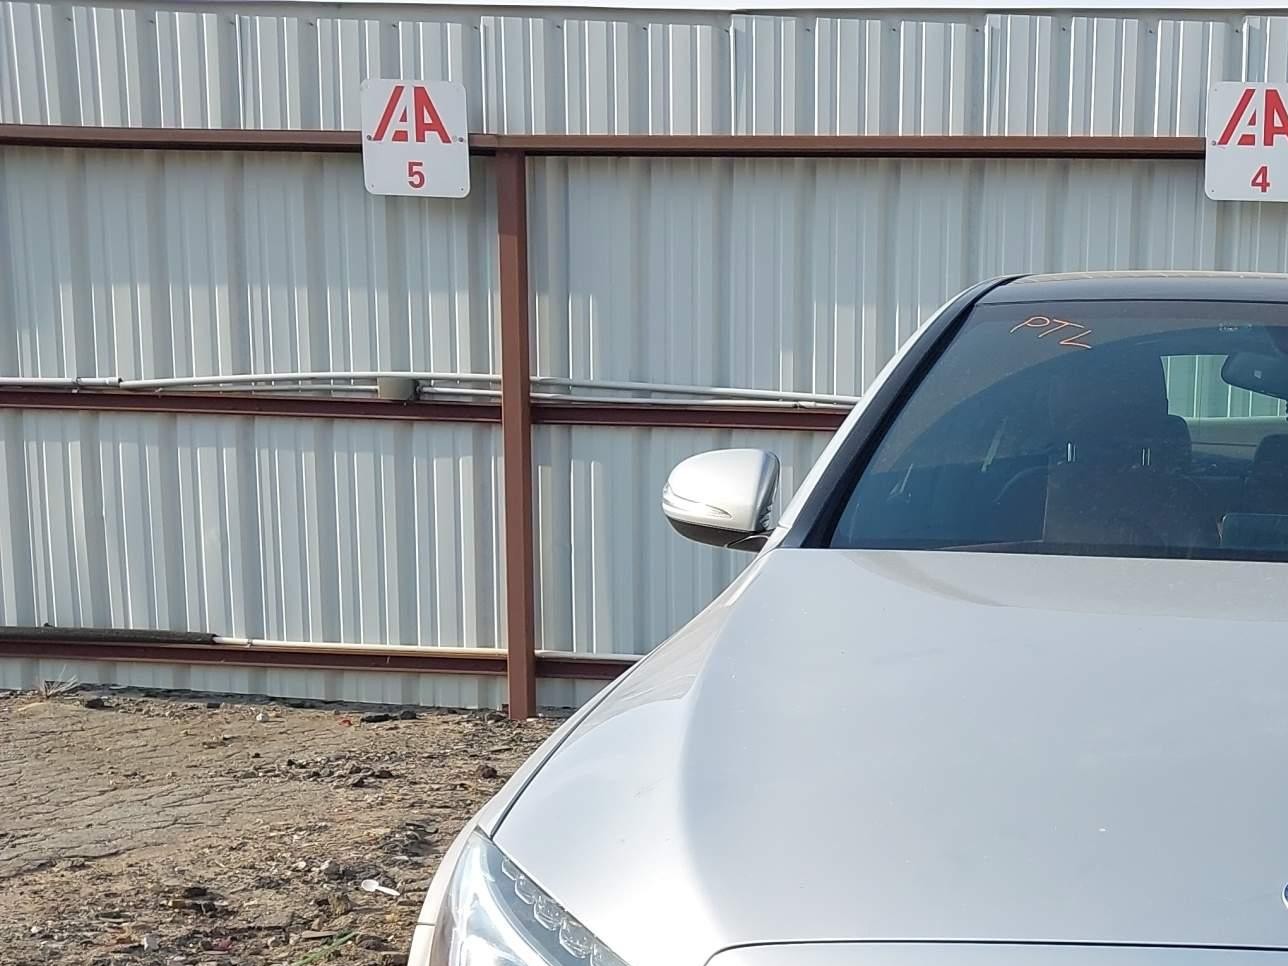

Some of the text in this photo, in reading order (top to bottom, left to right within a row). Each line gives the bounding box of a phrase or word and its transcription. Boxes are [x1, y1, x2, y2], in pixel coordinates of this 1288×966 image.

[407, 161, 426, 189] 5
[1250, 165, 1271, 193] 4
[1009, 315, 1093, 350] PTL
